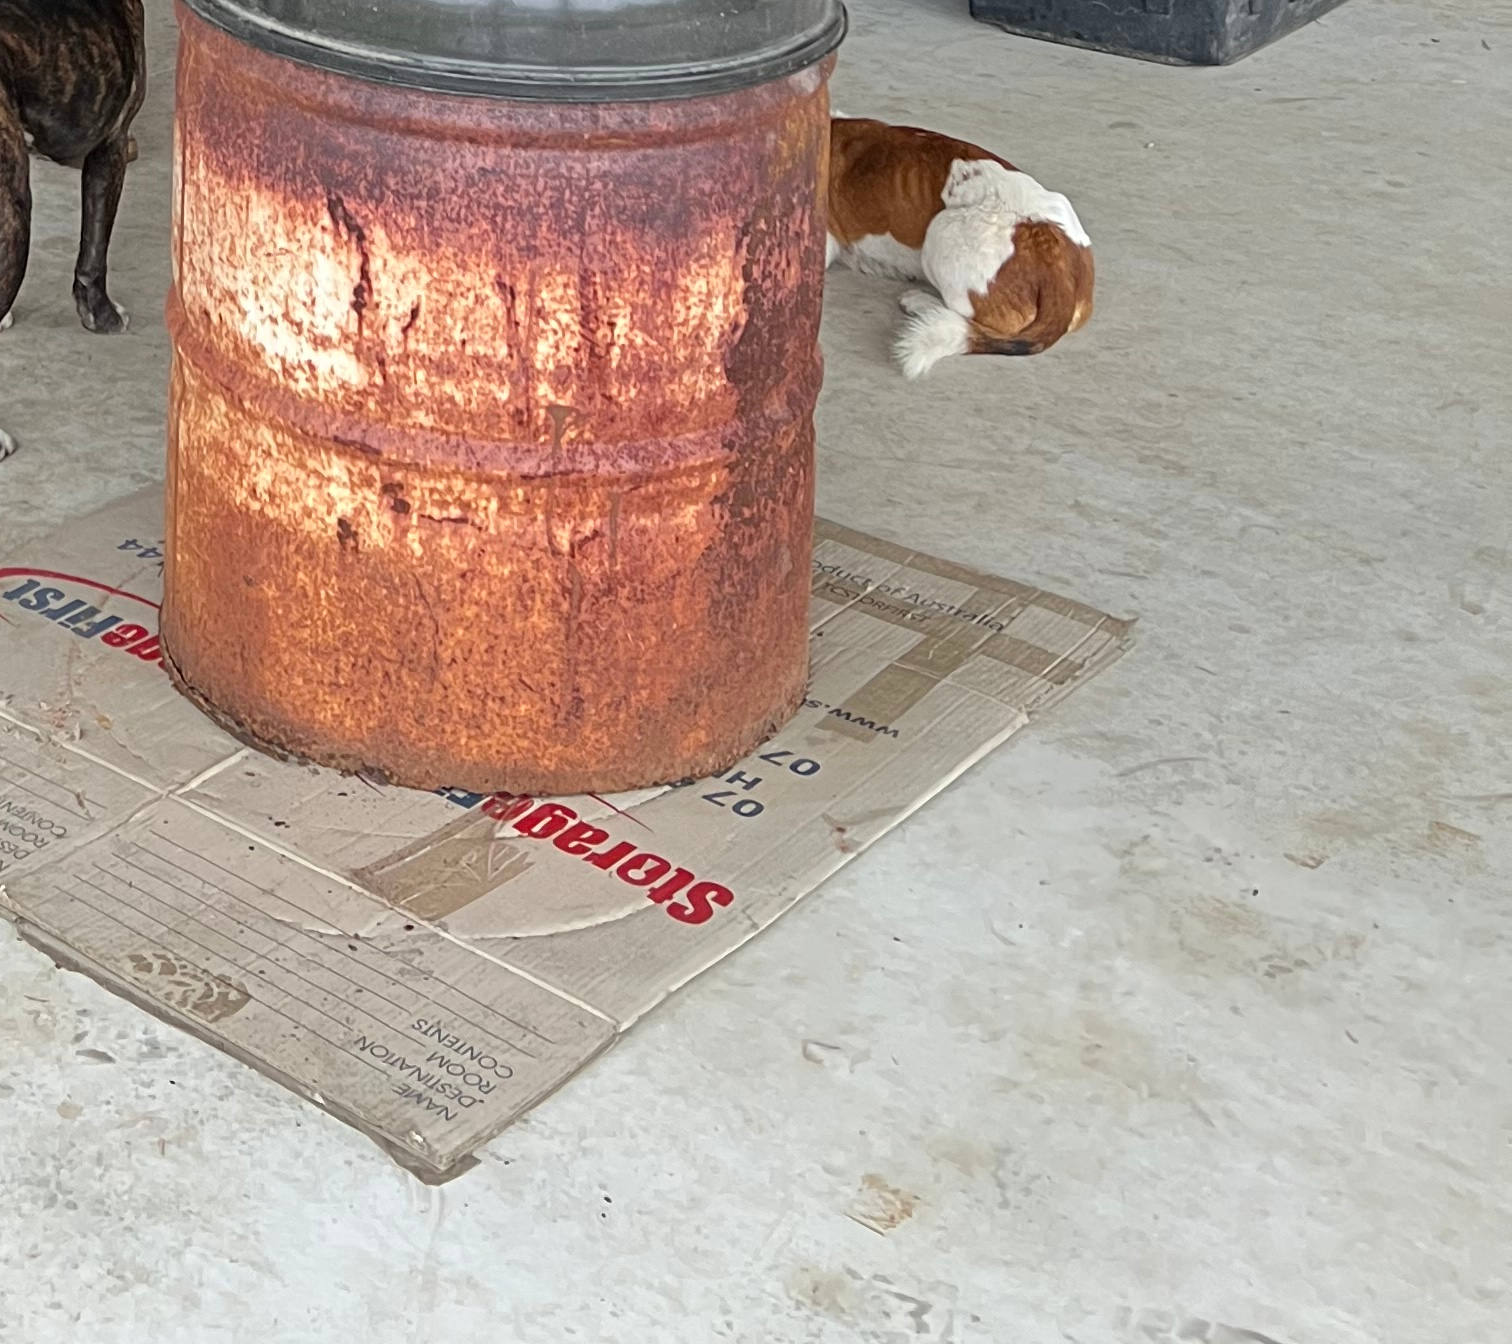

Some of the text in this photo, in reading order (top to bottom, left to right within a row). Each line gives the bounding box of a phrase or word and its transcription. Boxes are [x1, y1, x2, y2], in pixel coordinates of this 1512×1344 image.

[758, 749, 822, 778] 07
[703, 790, 766, 820] 07
[410, 1017, 515, 1082] CONTENTS
[353, 1034, 480, 1110] DESTINATION
[424, 1050, 497, 1095] ROOM
[392, 1084, 459, 1123] NAME
